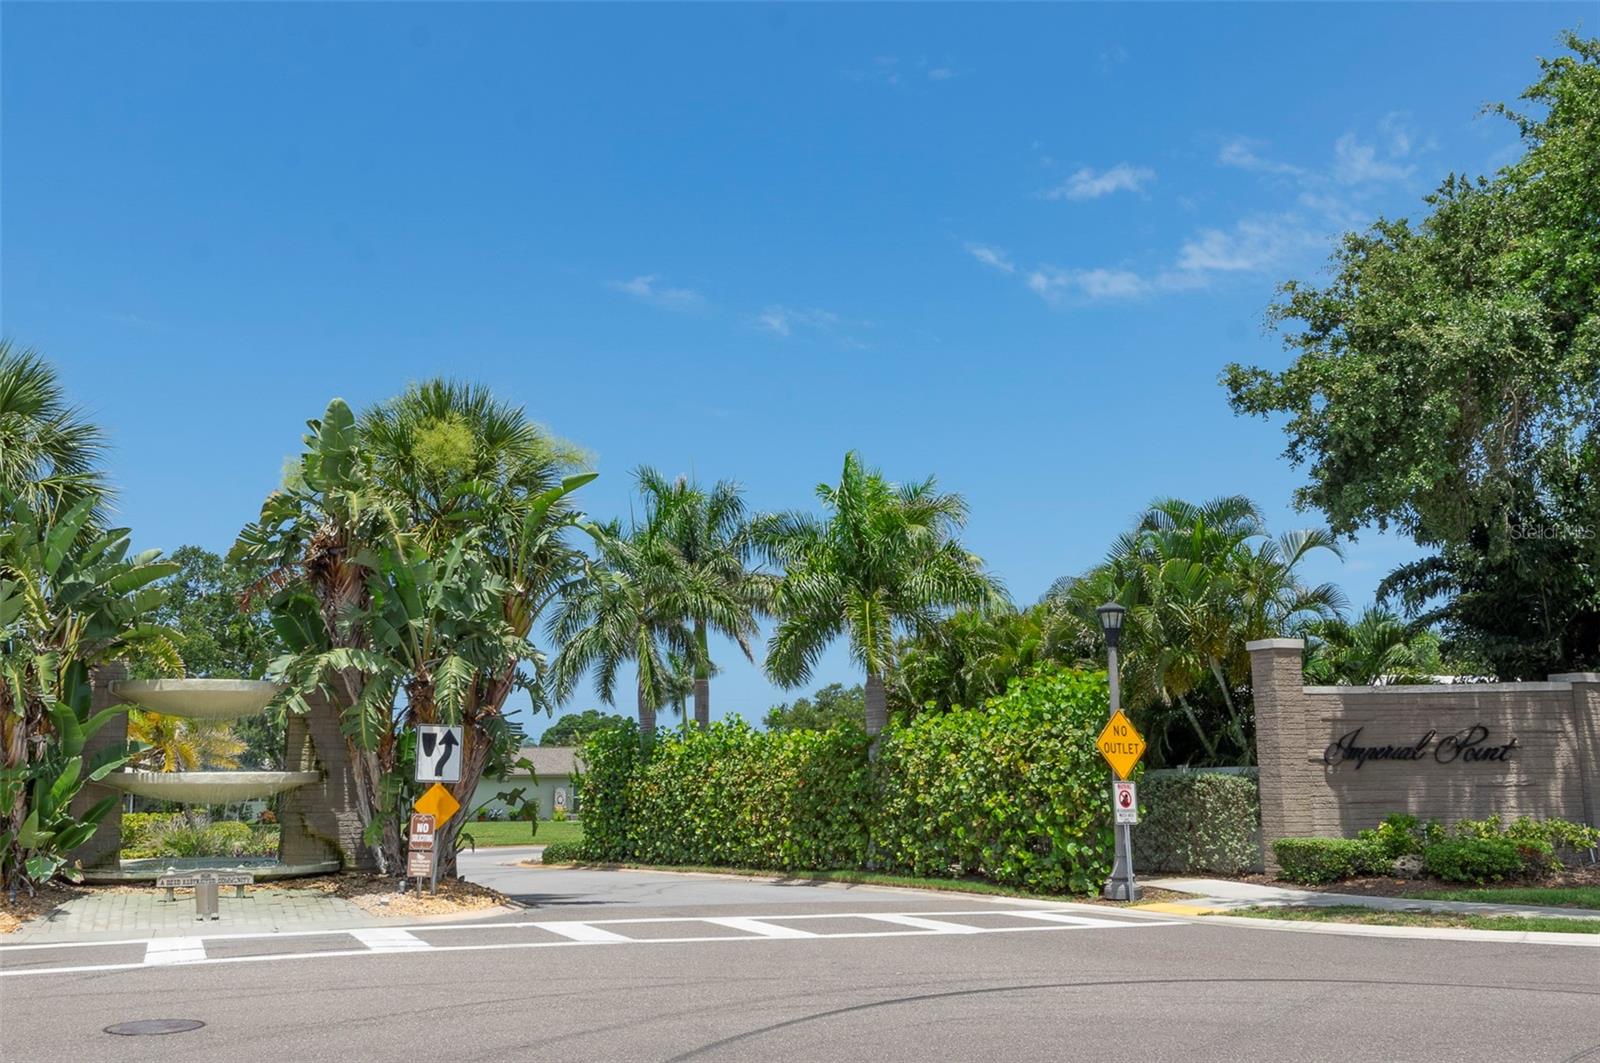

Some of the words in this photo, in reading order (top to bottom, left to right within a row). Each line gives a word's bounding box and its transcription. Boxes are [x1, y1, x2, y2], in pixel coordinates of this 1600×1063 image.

[1113, 726, 1127, 736] NO
[1104, 742, 1139, 754] OUTLET
[1324, 726, 1437, 770] Imperial
[1434, 723, 1523, 765] Point
[416, 823, 430, 833] NO
